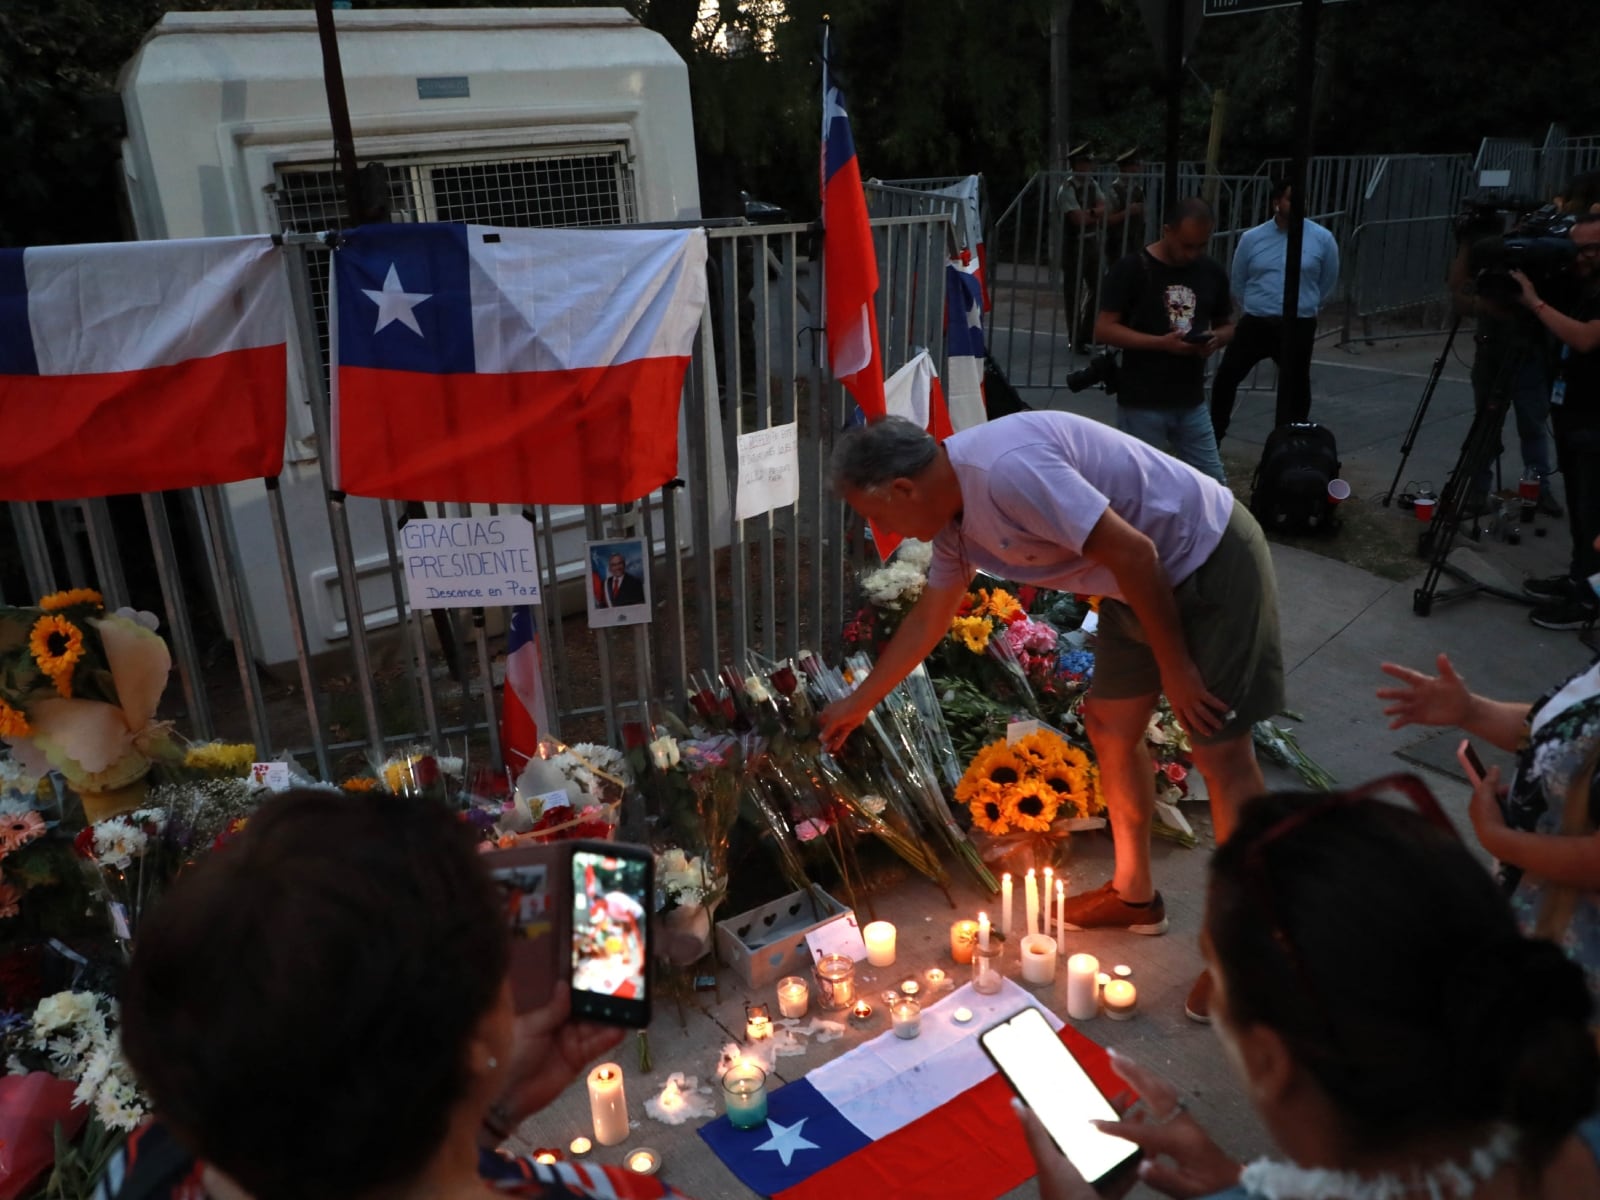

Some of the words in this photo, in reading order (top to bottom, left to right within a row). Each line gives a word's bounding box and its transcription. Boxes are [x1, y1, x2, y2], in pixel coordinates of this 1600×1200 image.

[403, 520, 505, 549] GRACIAS
[409, 549, 533, 578] PRESIDENTE
[488, 588, 502, 597] en
[505, 580, 537, 596] Paz
